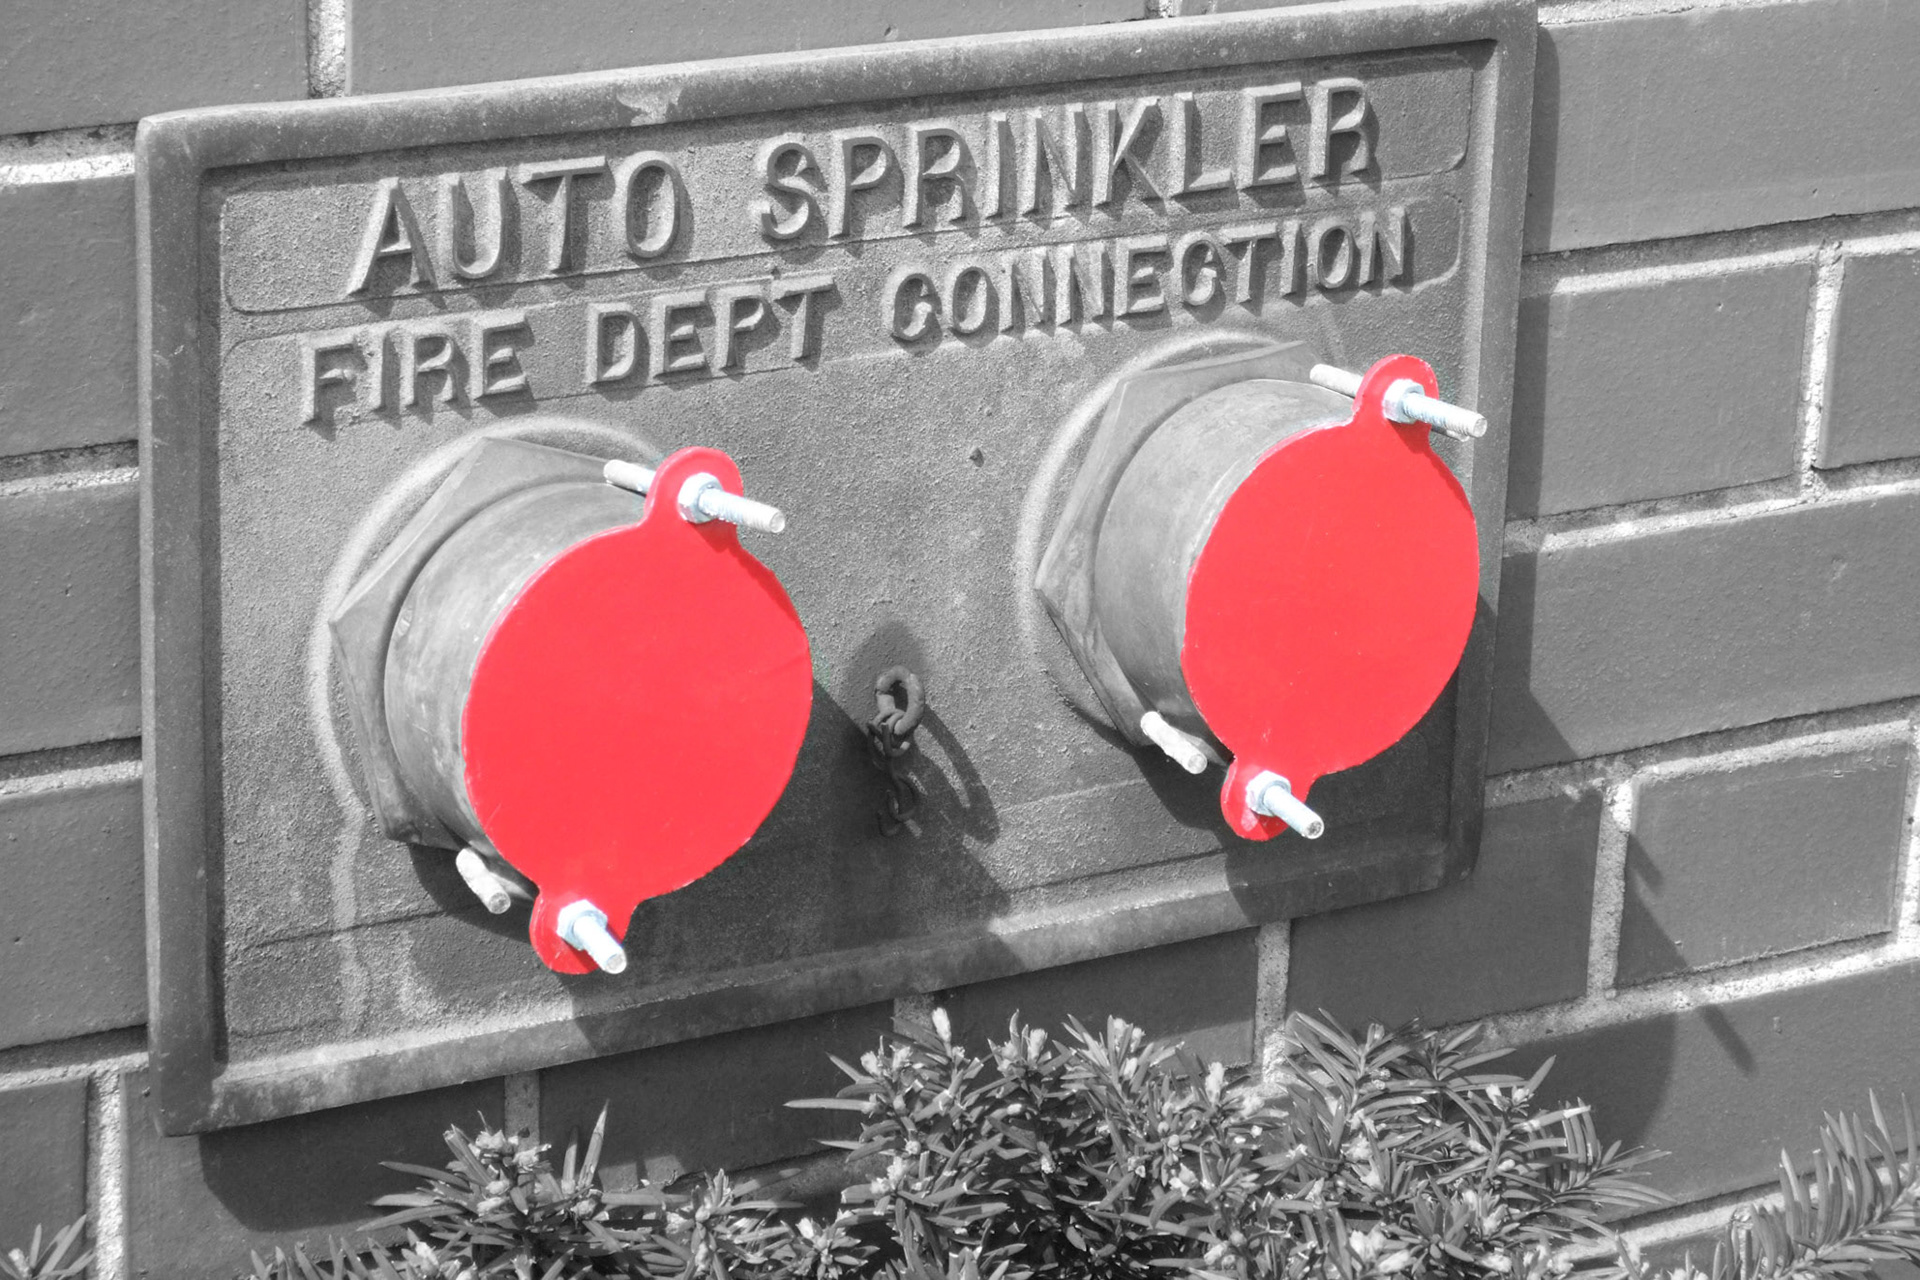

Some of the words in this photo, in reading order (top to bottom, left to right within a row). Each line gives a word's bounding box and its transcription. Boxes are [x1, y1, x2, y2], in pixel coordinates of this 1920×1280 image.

[347, 150, 682, 295] AUTO
[760, 78, 1372, 241] SPRINKLER
[303, 312, 530, 426] FIRE
[585, 275, 836, 386] DEPT
[890, 206, 1408, 342] CONNECTION
